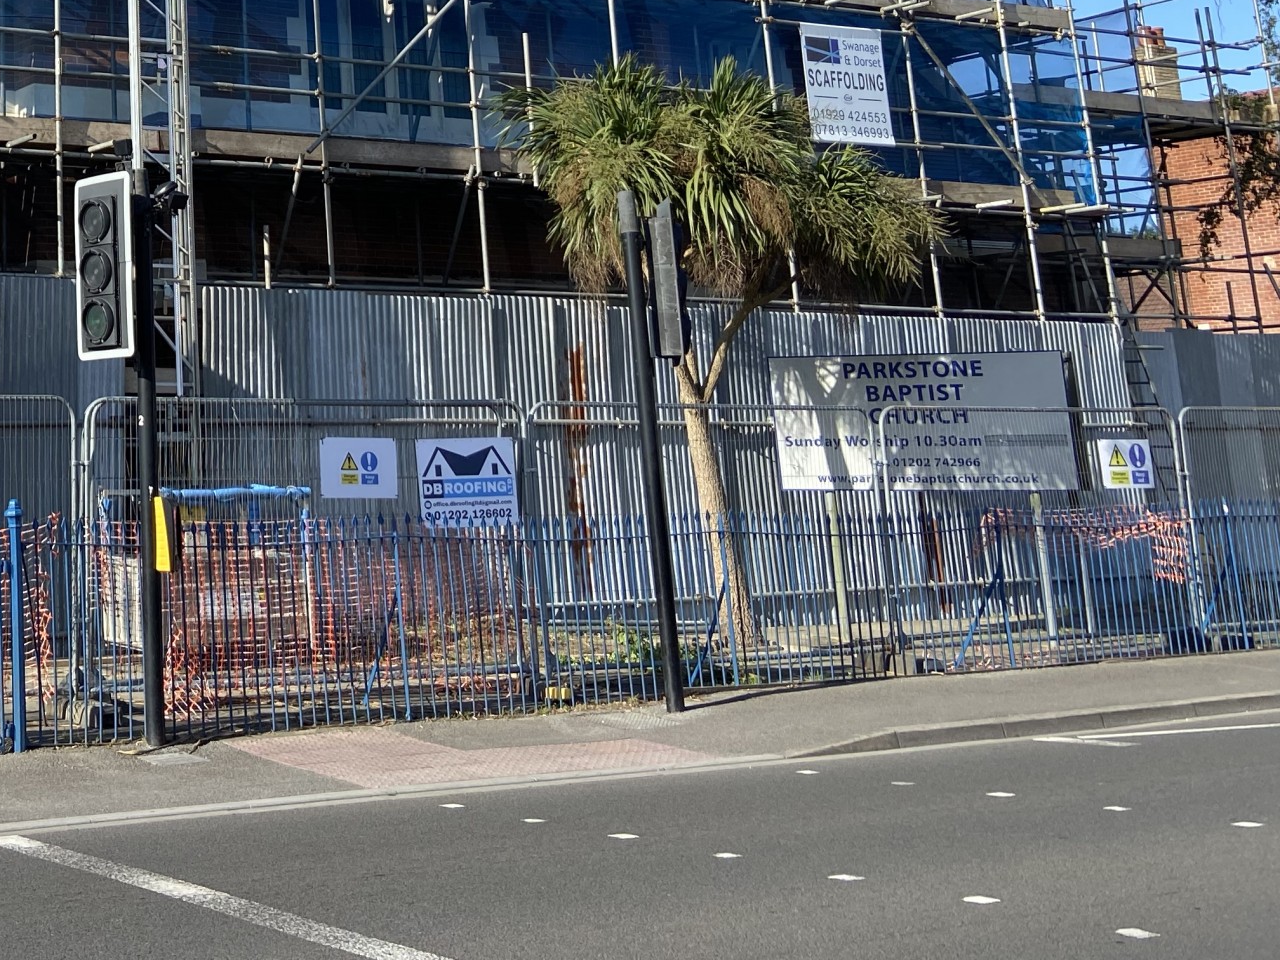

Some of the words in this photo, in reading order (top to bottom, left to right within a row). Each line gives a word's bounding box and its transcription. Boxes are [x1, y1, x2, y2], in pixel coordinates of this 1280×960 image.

[842, 40, 879, 54] Swanage
[844, 55, 851, 65] &
[854, 56, 881, 68] Dorset
[808, 68, 884, 92] SCAFFOLDING
[814, 108, 844, 120] 01929
[848, 109, 887, 124] 424553
[816, 124, 847, 136] 07813
[851, 125, 889, 139] 346993
[842, 360, 983, 379] PARKSTONE
[866, 384, 964, 402] BAPTIST
[138, 415, 144, 426] 2
[869, 407, 968, 424] CHURCH
[786, 435, 840, 449] Sunday
[845, 435, 909, 449] Woship
[915, 435, 982, 447] 10.30am
[893, 458, 930, 467] 01202
[934, 458, 981, 467] 742966
[818, 473, 1039, 484] www.parsonebaptistchurch.co.uk
[424, 483, 443, 495] DB
[444, 480, 507, 494] ROOFING
[473, 508, 512, 519] 126602
